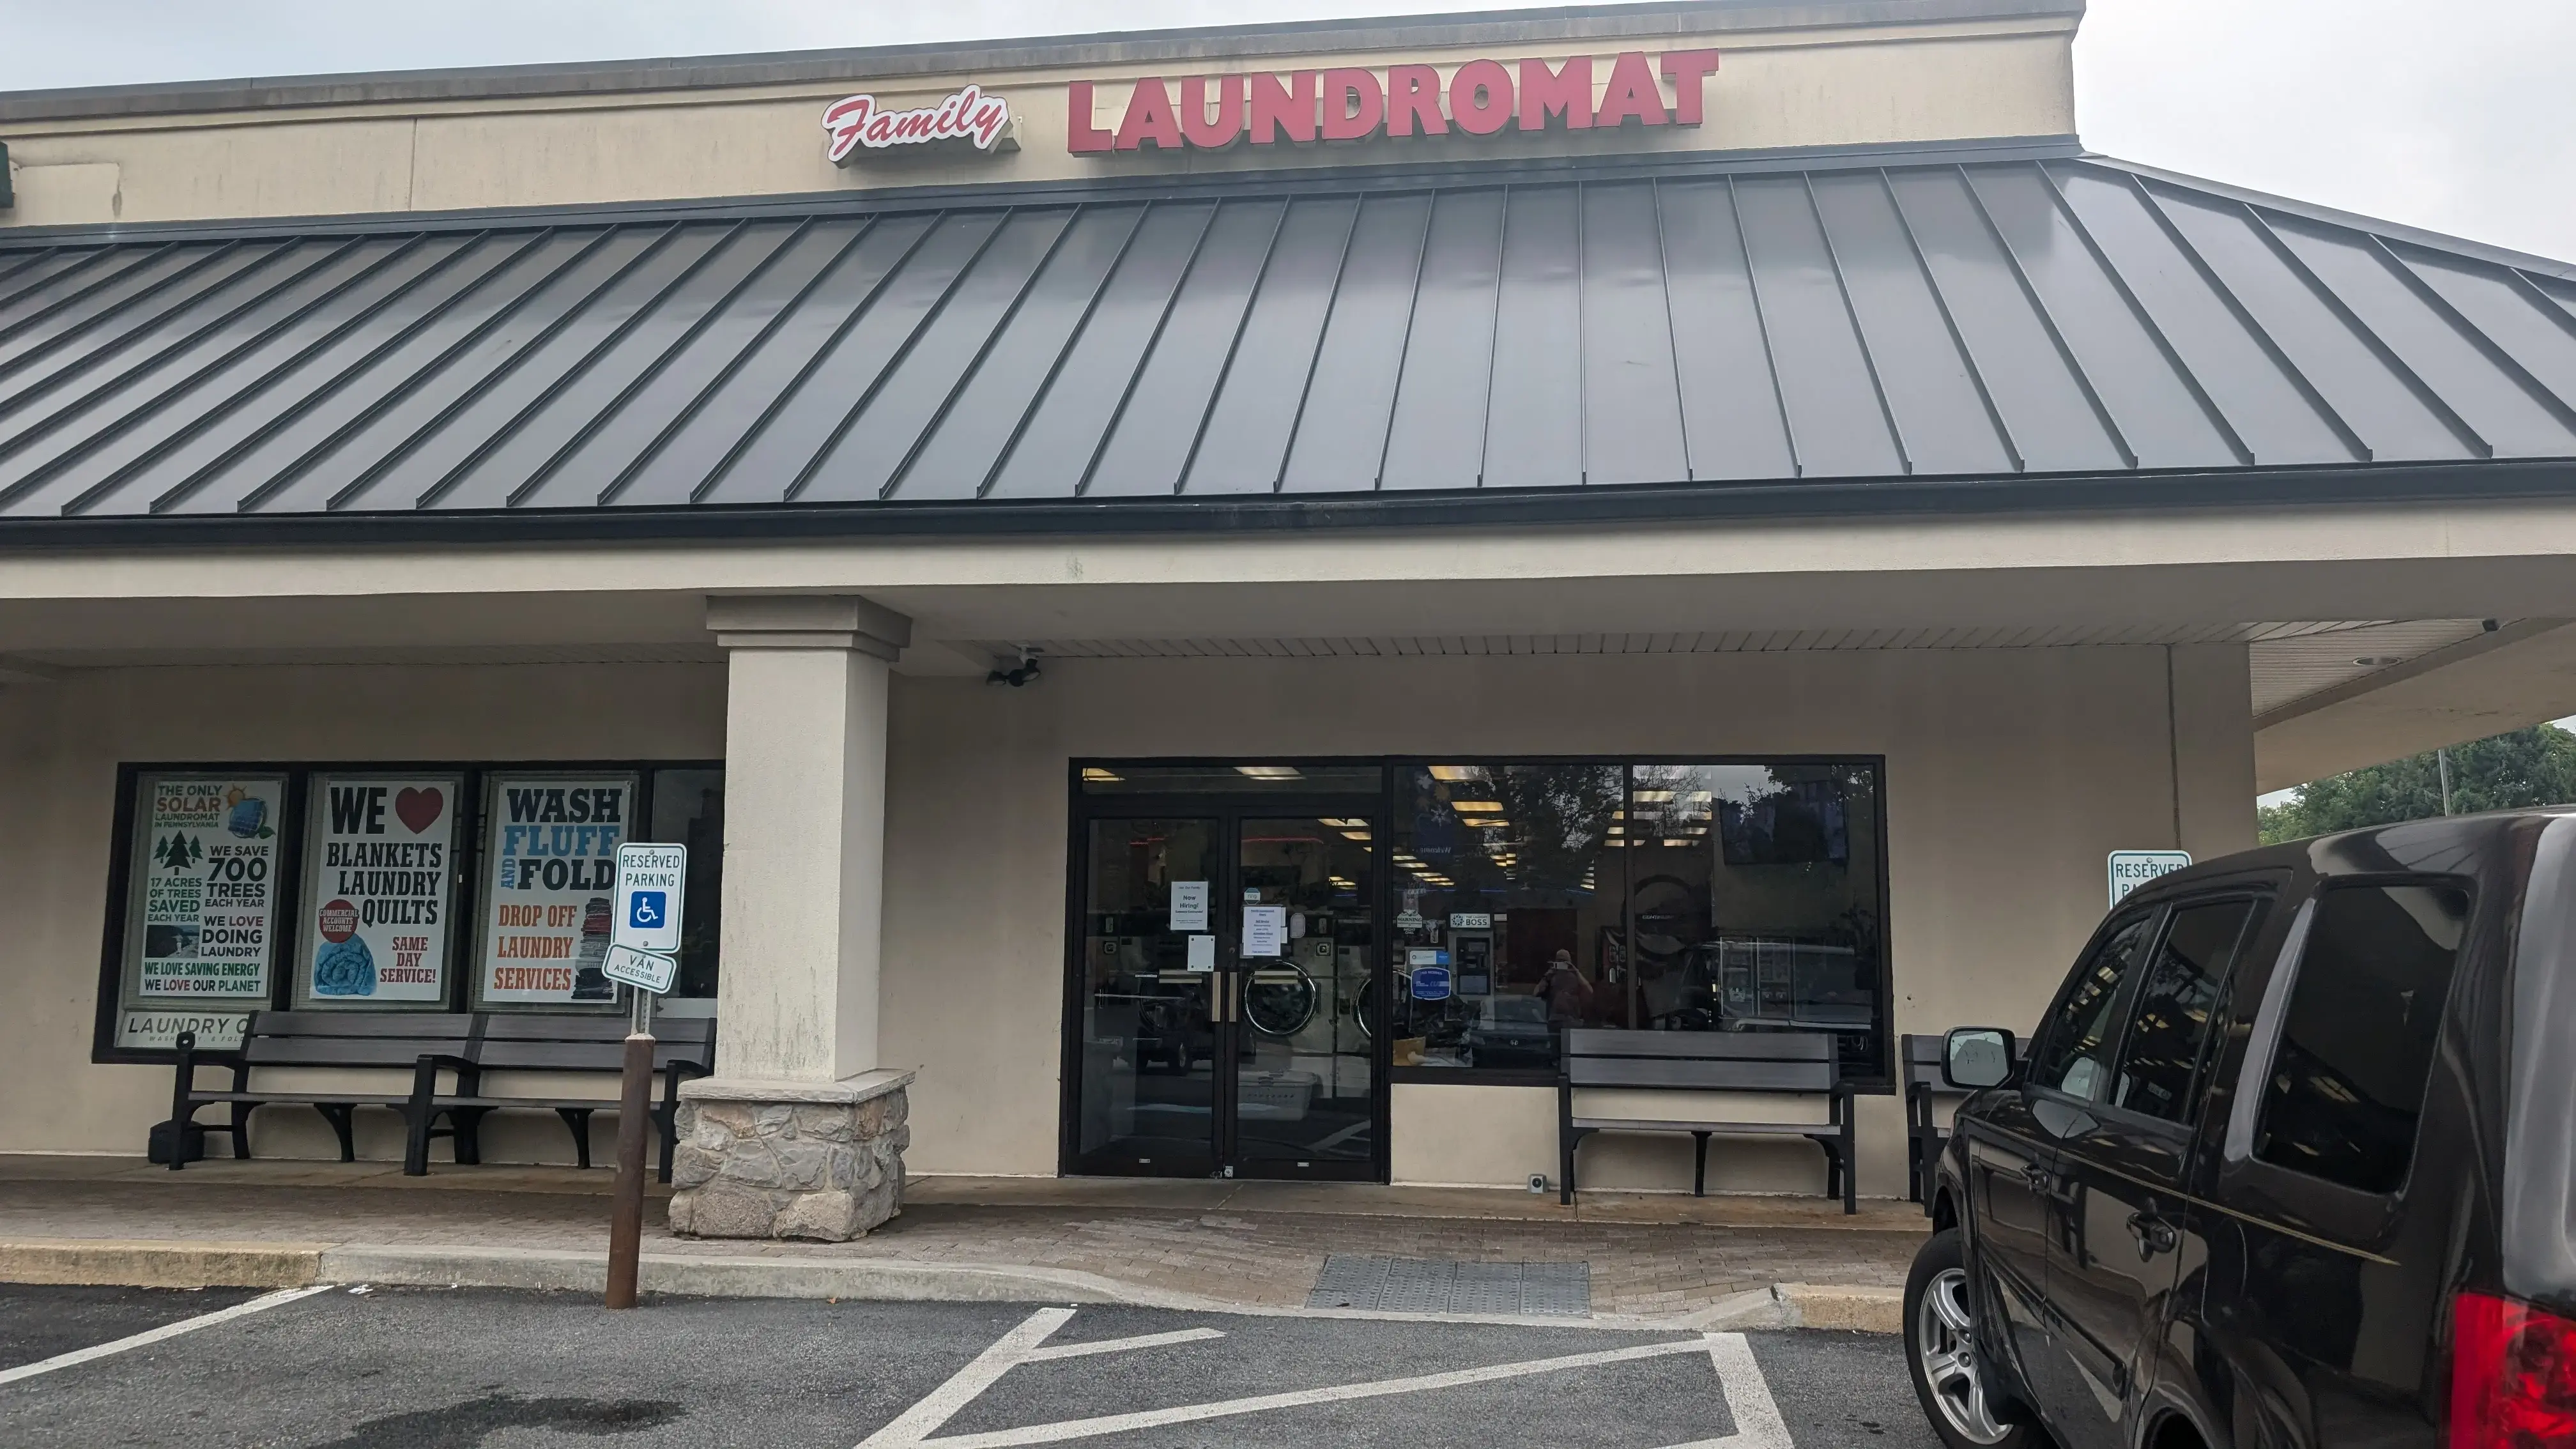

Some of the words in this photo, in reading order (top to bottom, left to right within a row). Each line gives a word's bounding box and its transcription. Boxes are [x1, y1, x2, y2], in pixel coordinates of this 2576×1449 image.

[824, 88, 1008, 160] Family
[1068, 49, 1719, 155] LAUNDROMAT
[158, 785, 183, 796] THE
[187, 785, 222, 796] ONLY
[157, 797, 221, 812] SOLAR
[330, 787, 387, 834] WE
[507, 788, 622, 823] WASH
[155, 813, 220, 822] LAUNDROMAT
[503, 825, 620, 856] FLUFF
[210, 846, 232, 856] WE
[234, 846, 268, 856] SAVE
[326, 843, 442, 868] BLANKETS
[207, 857, 268, 882] 700
[623, 855, 680, 869] RESERVED
[150, 877, 162, 887] 17
[164, 878, 202, 887] ACRES
[500, 858, 516, 889] AND
[518, 859, 617, 891] FOLD
[625, 873, 675, 887] PARKING
[206, 883, 266, 898] TREES
[338, 871, 441, 896] LAUNDRY
[150, 889, 165, 898] OF
[167, 889, 201, 898] TREES
[149, 900, 200, 913] SAVED
[205, 898, 233, 907] EACH
[236, 898, 264, 907] YEAR
[148, 914, 171, 922] EACH
[174, 914, 199, 922] YEAR
[319, 908, 359, 917] COMMERCIAL
[362, 899, 438, 928] QUILTS
[498, 905, 542, 927] DROP
[548, 905, 577, 927] OFF
[204, 916, 226, 926] WE
[229, 916, 263, 926] LOVE
[323, 924, 352, 932] WELCOME
[201, 929, 263, 944] DOING
[392, 937, 428, 951] SAME
[201, 947, 261, 957] LAUNDRY
[497, 936, 573, 958] LAUNDRY
[396, 953, 422, 967] DAY
[629, 954, 655, 971] VAN
[144, 962, 159, 975] WE
[161, 962, 183, 975] LOVE
[185, 962, 220, 976] SAVING
[222, 963, 260, 976] ENERGY
[380, 968, 436, 983] SERVICE!
[614, 964, 662, 984] ACCESSIBLE
[144, 979, 161, 991] WE
[164, 979, 190, 991] LOVE
[193, 979, 215, 992] OUR
[218, 980, 261, 992] PLANET
[494, 967, 571, 990] SERVICES
[128, 1018, 229, 1034] LAUNDRY
